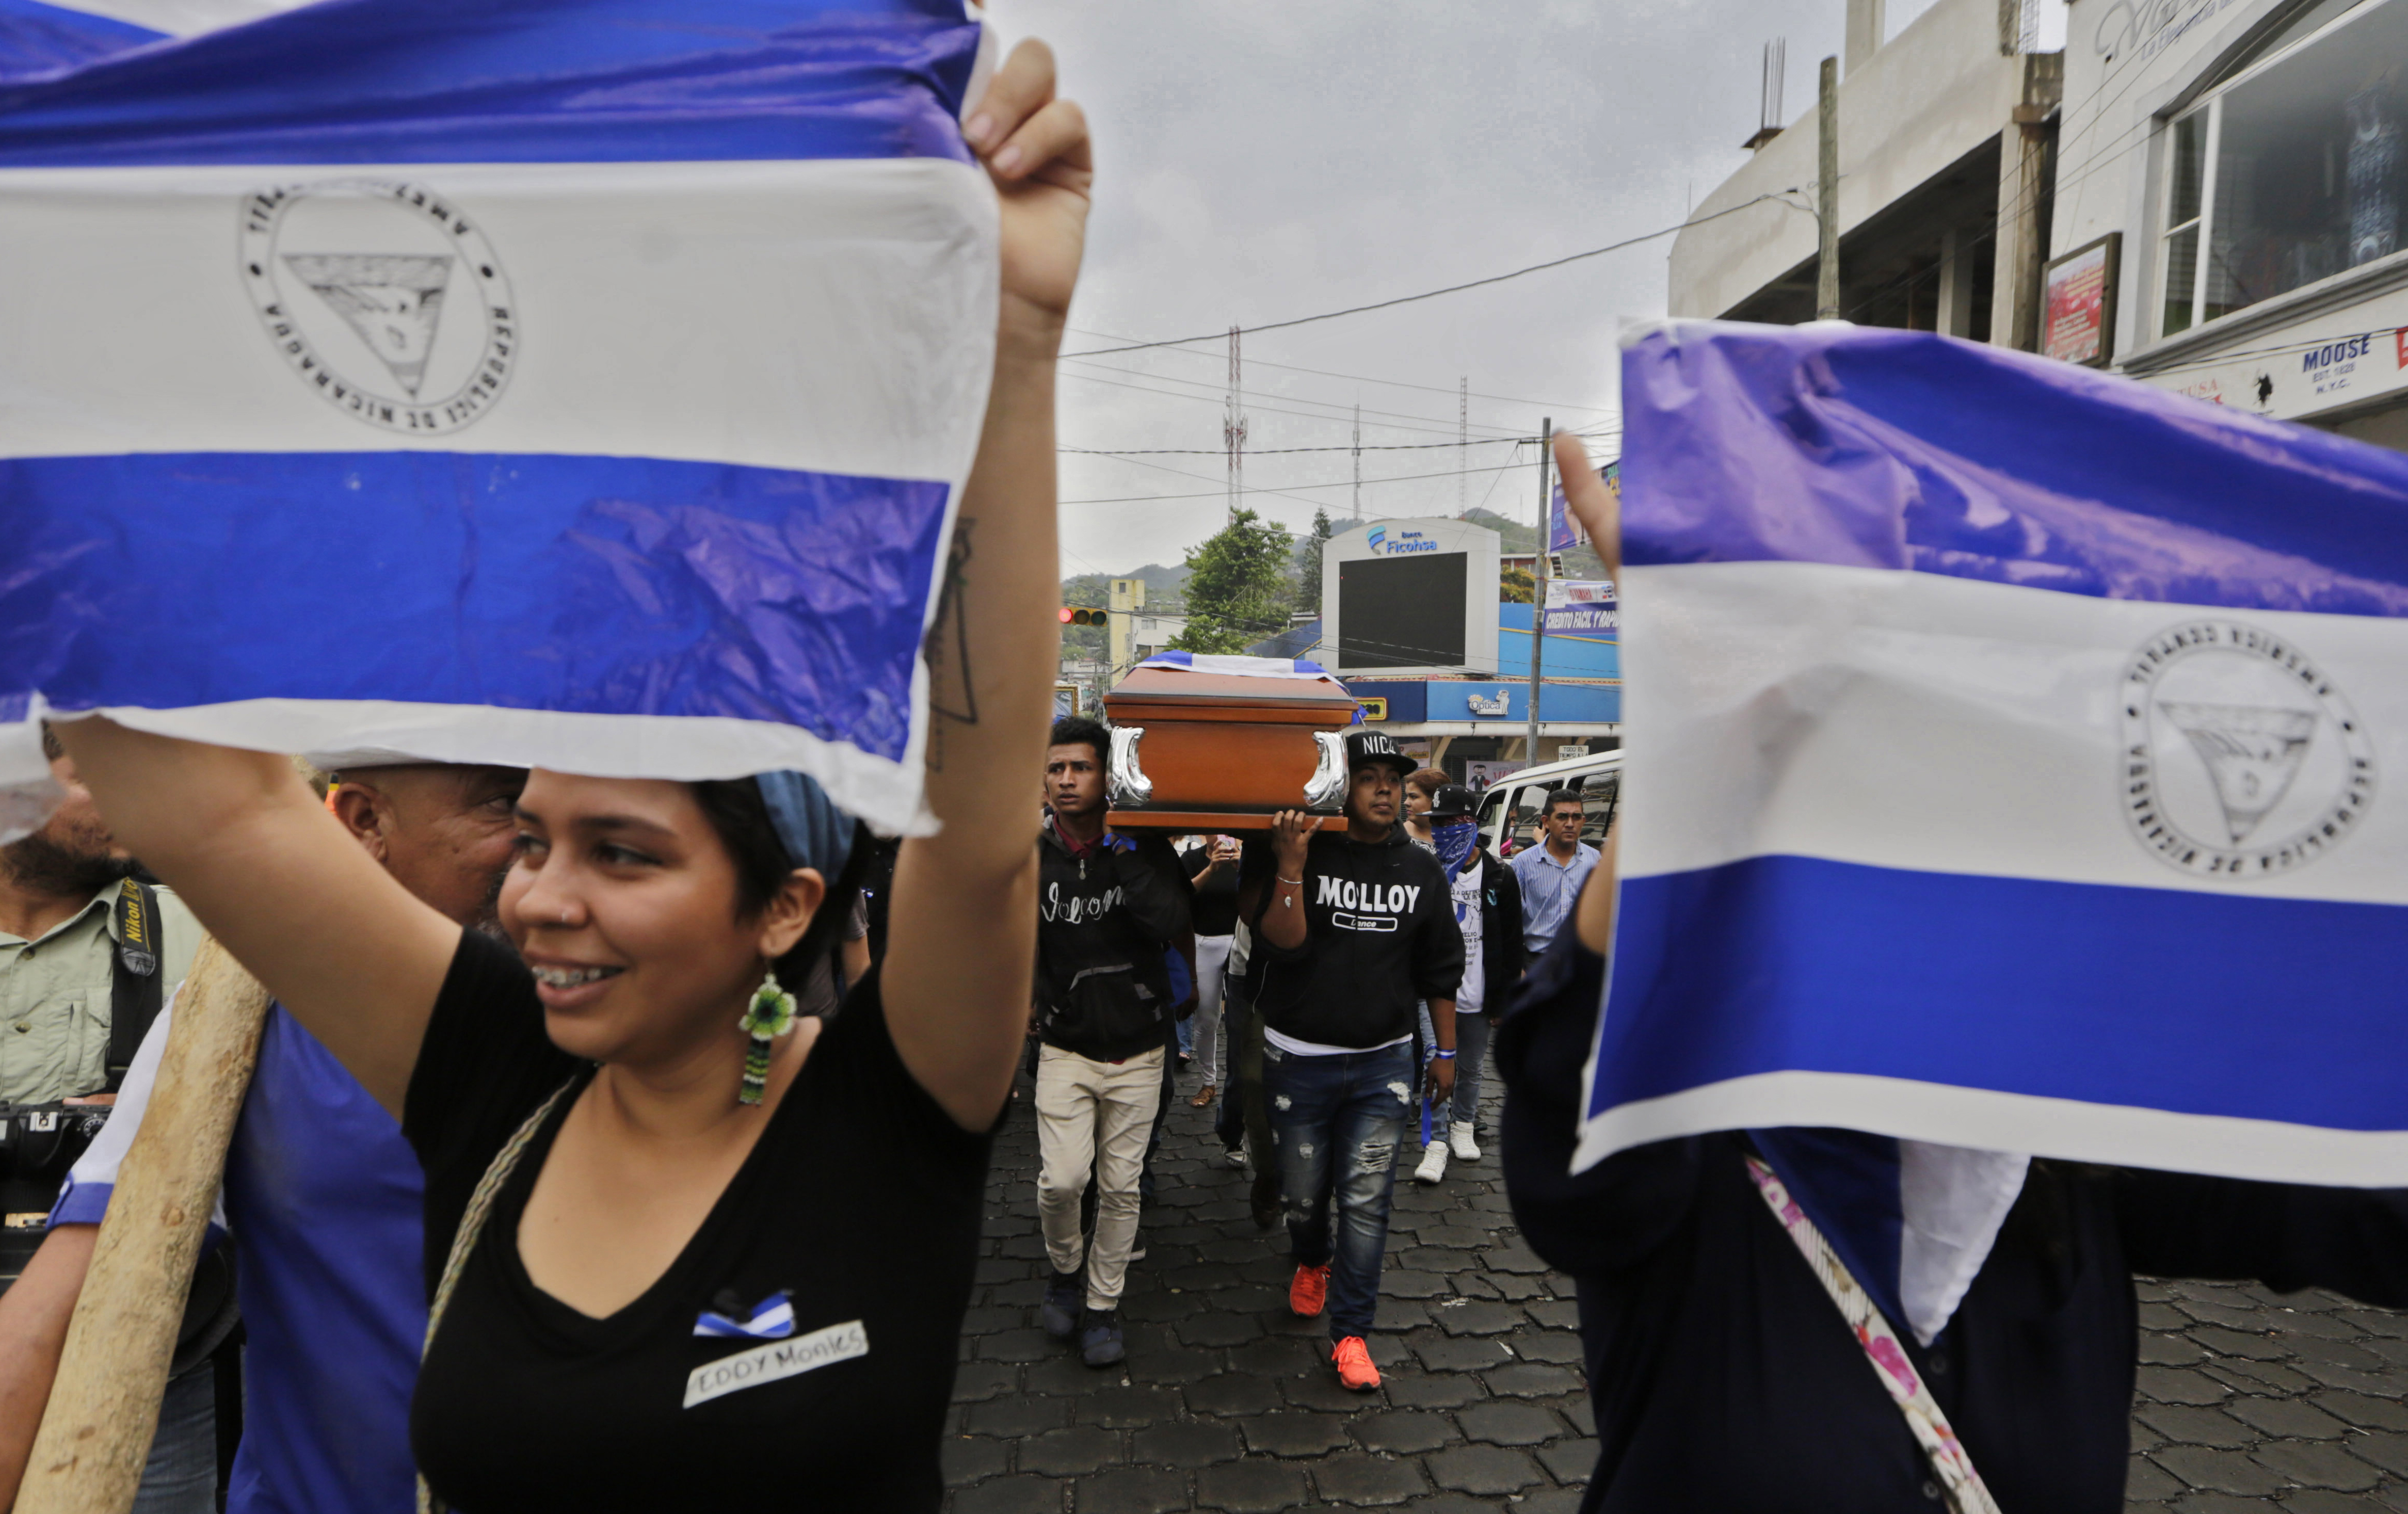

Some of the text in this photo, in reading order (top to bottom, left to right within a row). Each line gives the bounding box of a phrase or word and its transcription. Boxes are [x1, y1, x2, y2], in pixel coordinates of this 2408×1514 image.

[2303, 333, 2372, 373] MOOSE
[1386, 539, 1437, 554] Ficohsa
[1546, 611, 1574, 629] CREDITO
[1572, 610, 1593, 629] FACIL
[1593, 610, 1601, 628] Y
[1315, 875, 1421, 914] MOLLOY
[125, 900, 143, 943] Nikon
[1350, 919, 1377, 928] Dance
